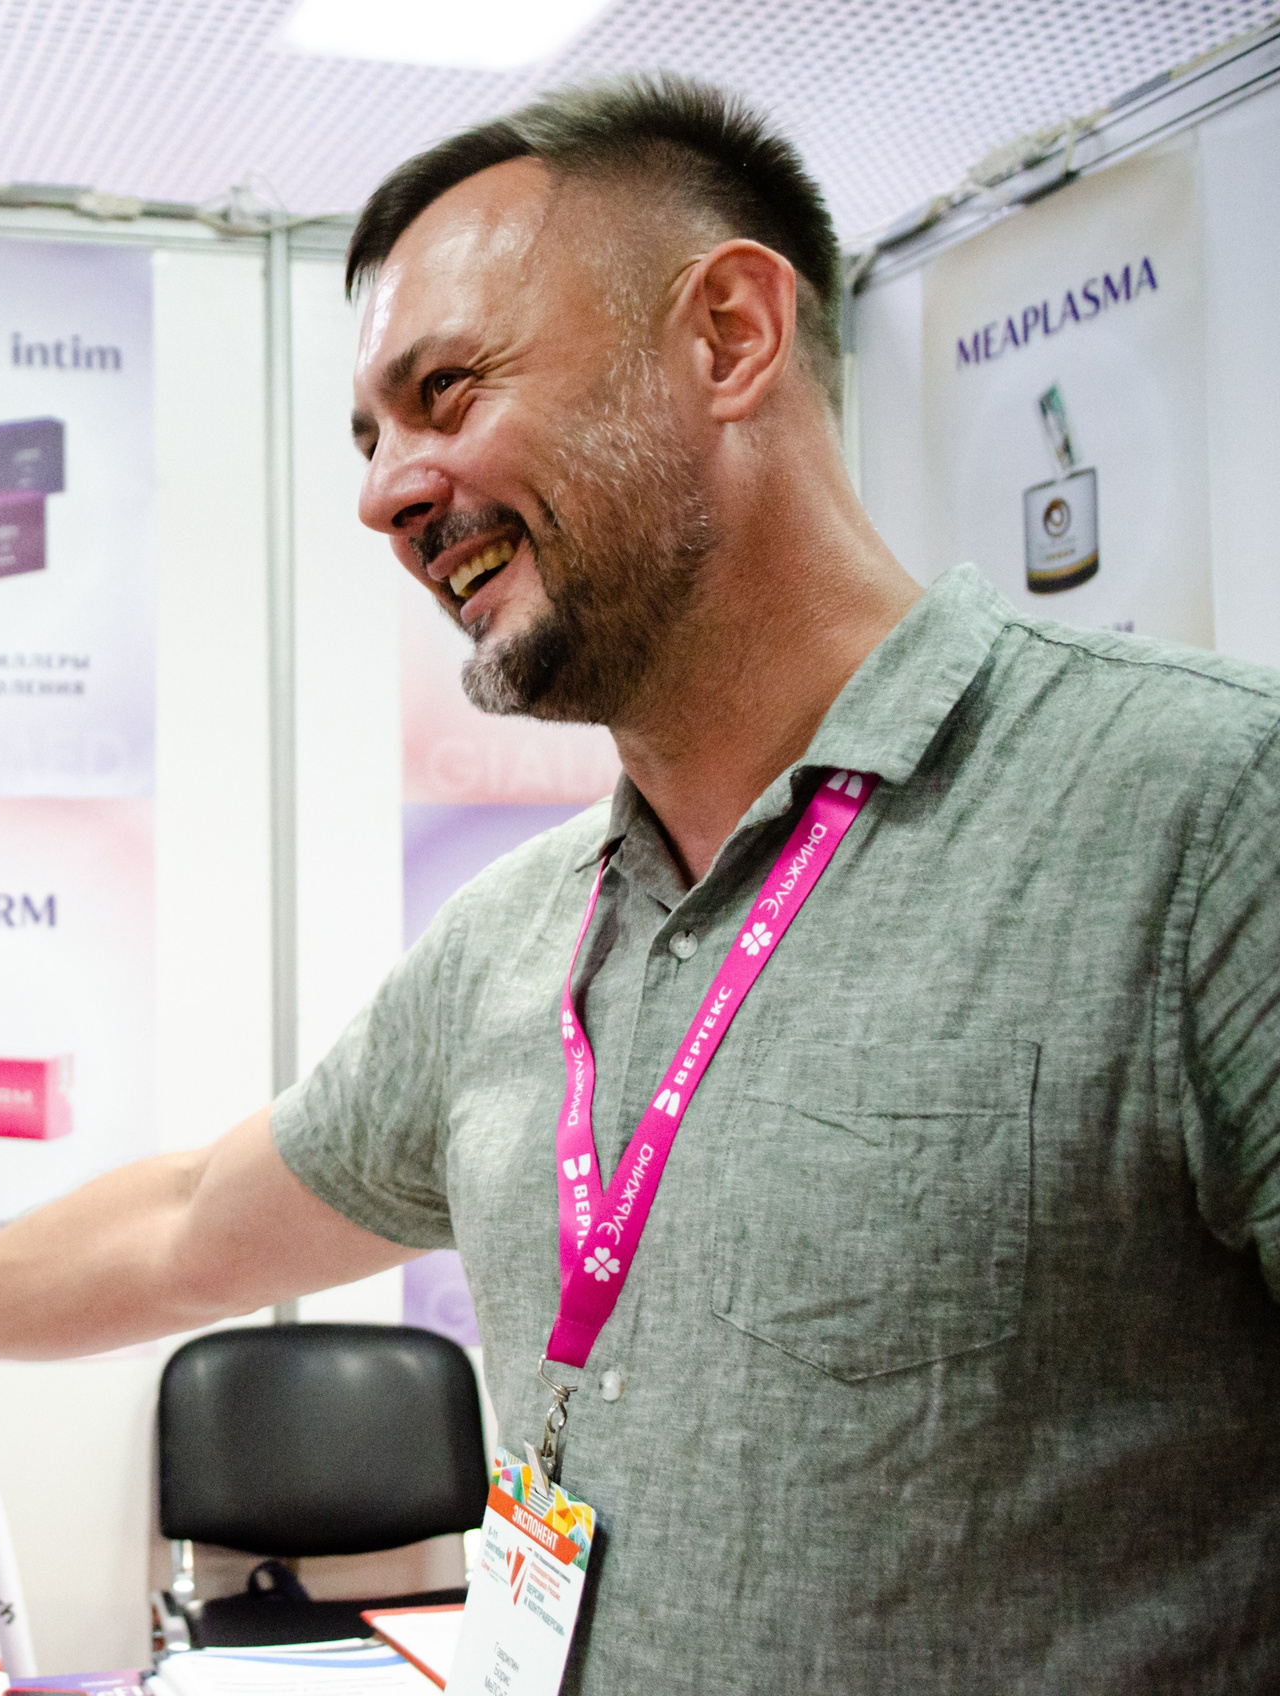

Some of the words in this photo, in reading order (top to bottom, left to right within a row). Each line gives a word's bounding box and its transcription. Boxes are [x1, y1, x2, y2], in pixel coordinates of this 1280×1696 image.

[956, 255, 1159, 369] MEAPLASMA
[11, 331, 123, 372] intim
[674, 986, 732, 1086] ВЕРТЕКС
[512, 1504, 559, 1551] ЭКСПОНЕНТ
[494, 1662, 511, 1686] Борис
